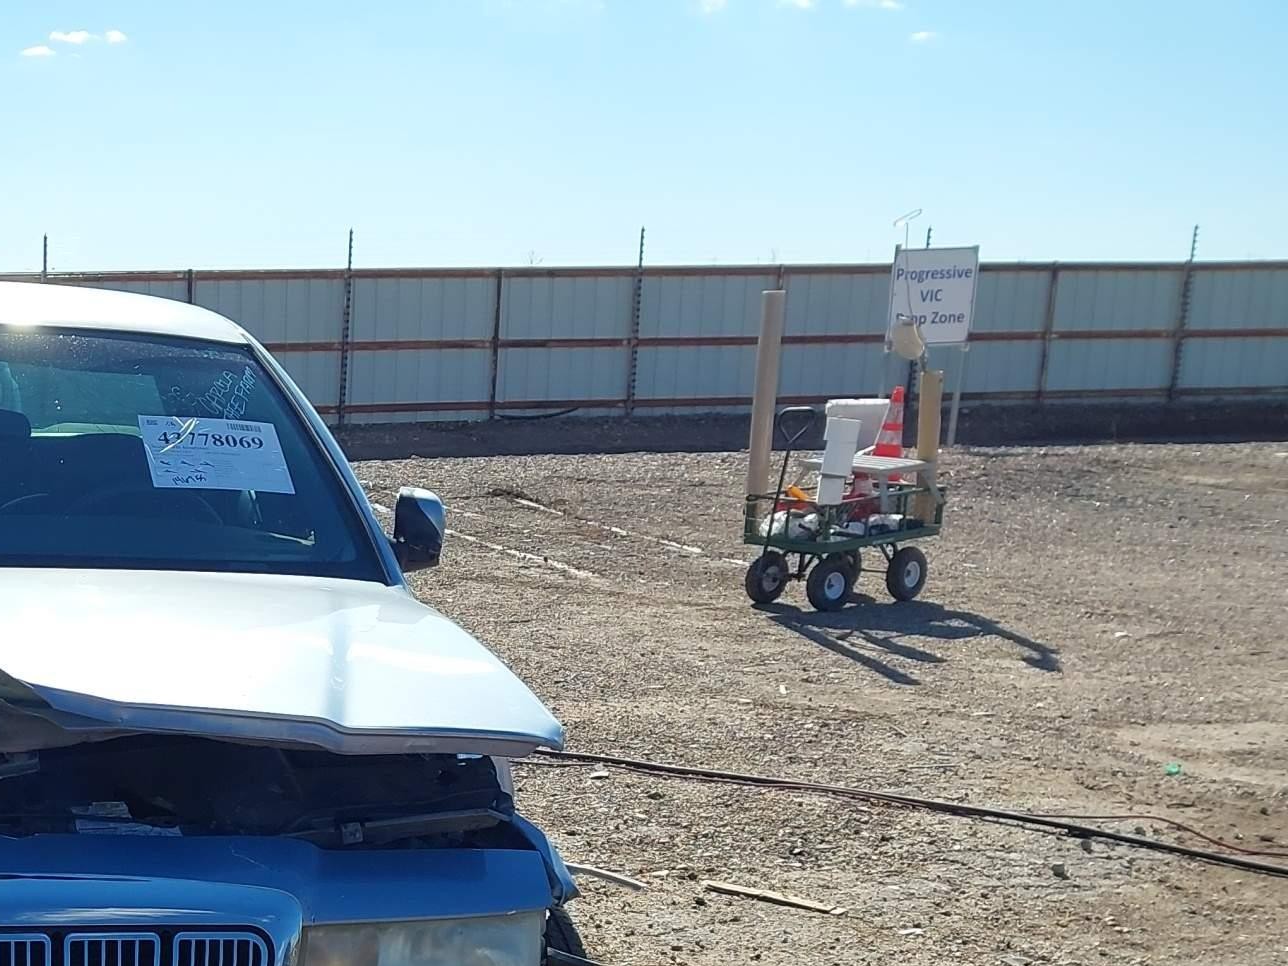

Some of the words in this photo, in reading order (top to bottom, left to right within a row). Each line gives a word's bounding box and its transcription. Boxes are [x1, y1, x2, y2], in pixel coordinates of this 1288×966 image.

[896, 265, 973, 283] Progressive
[920, 289, 943, 303] VIC
[931, 311, 965, 325] Zone
